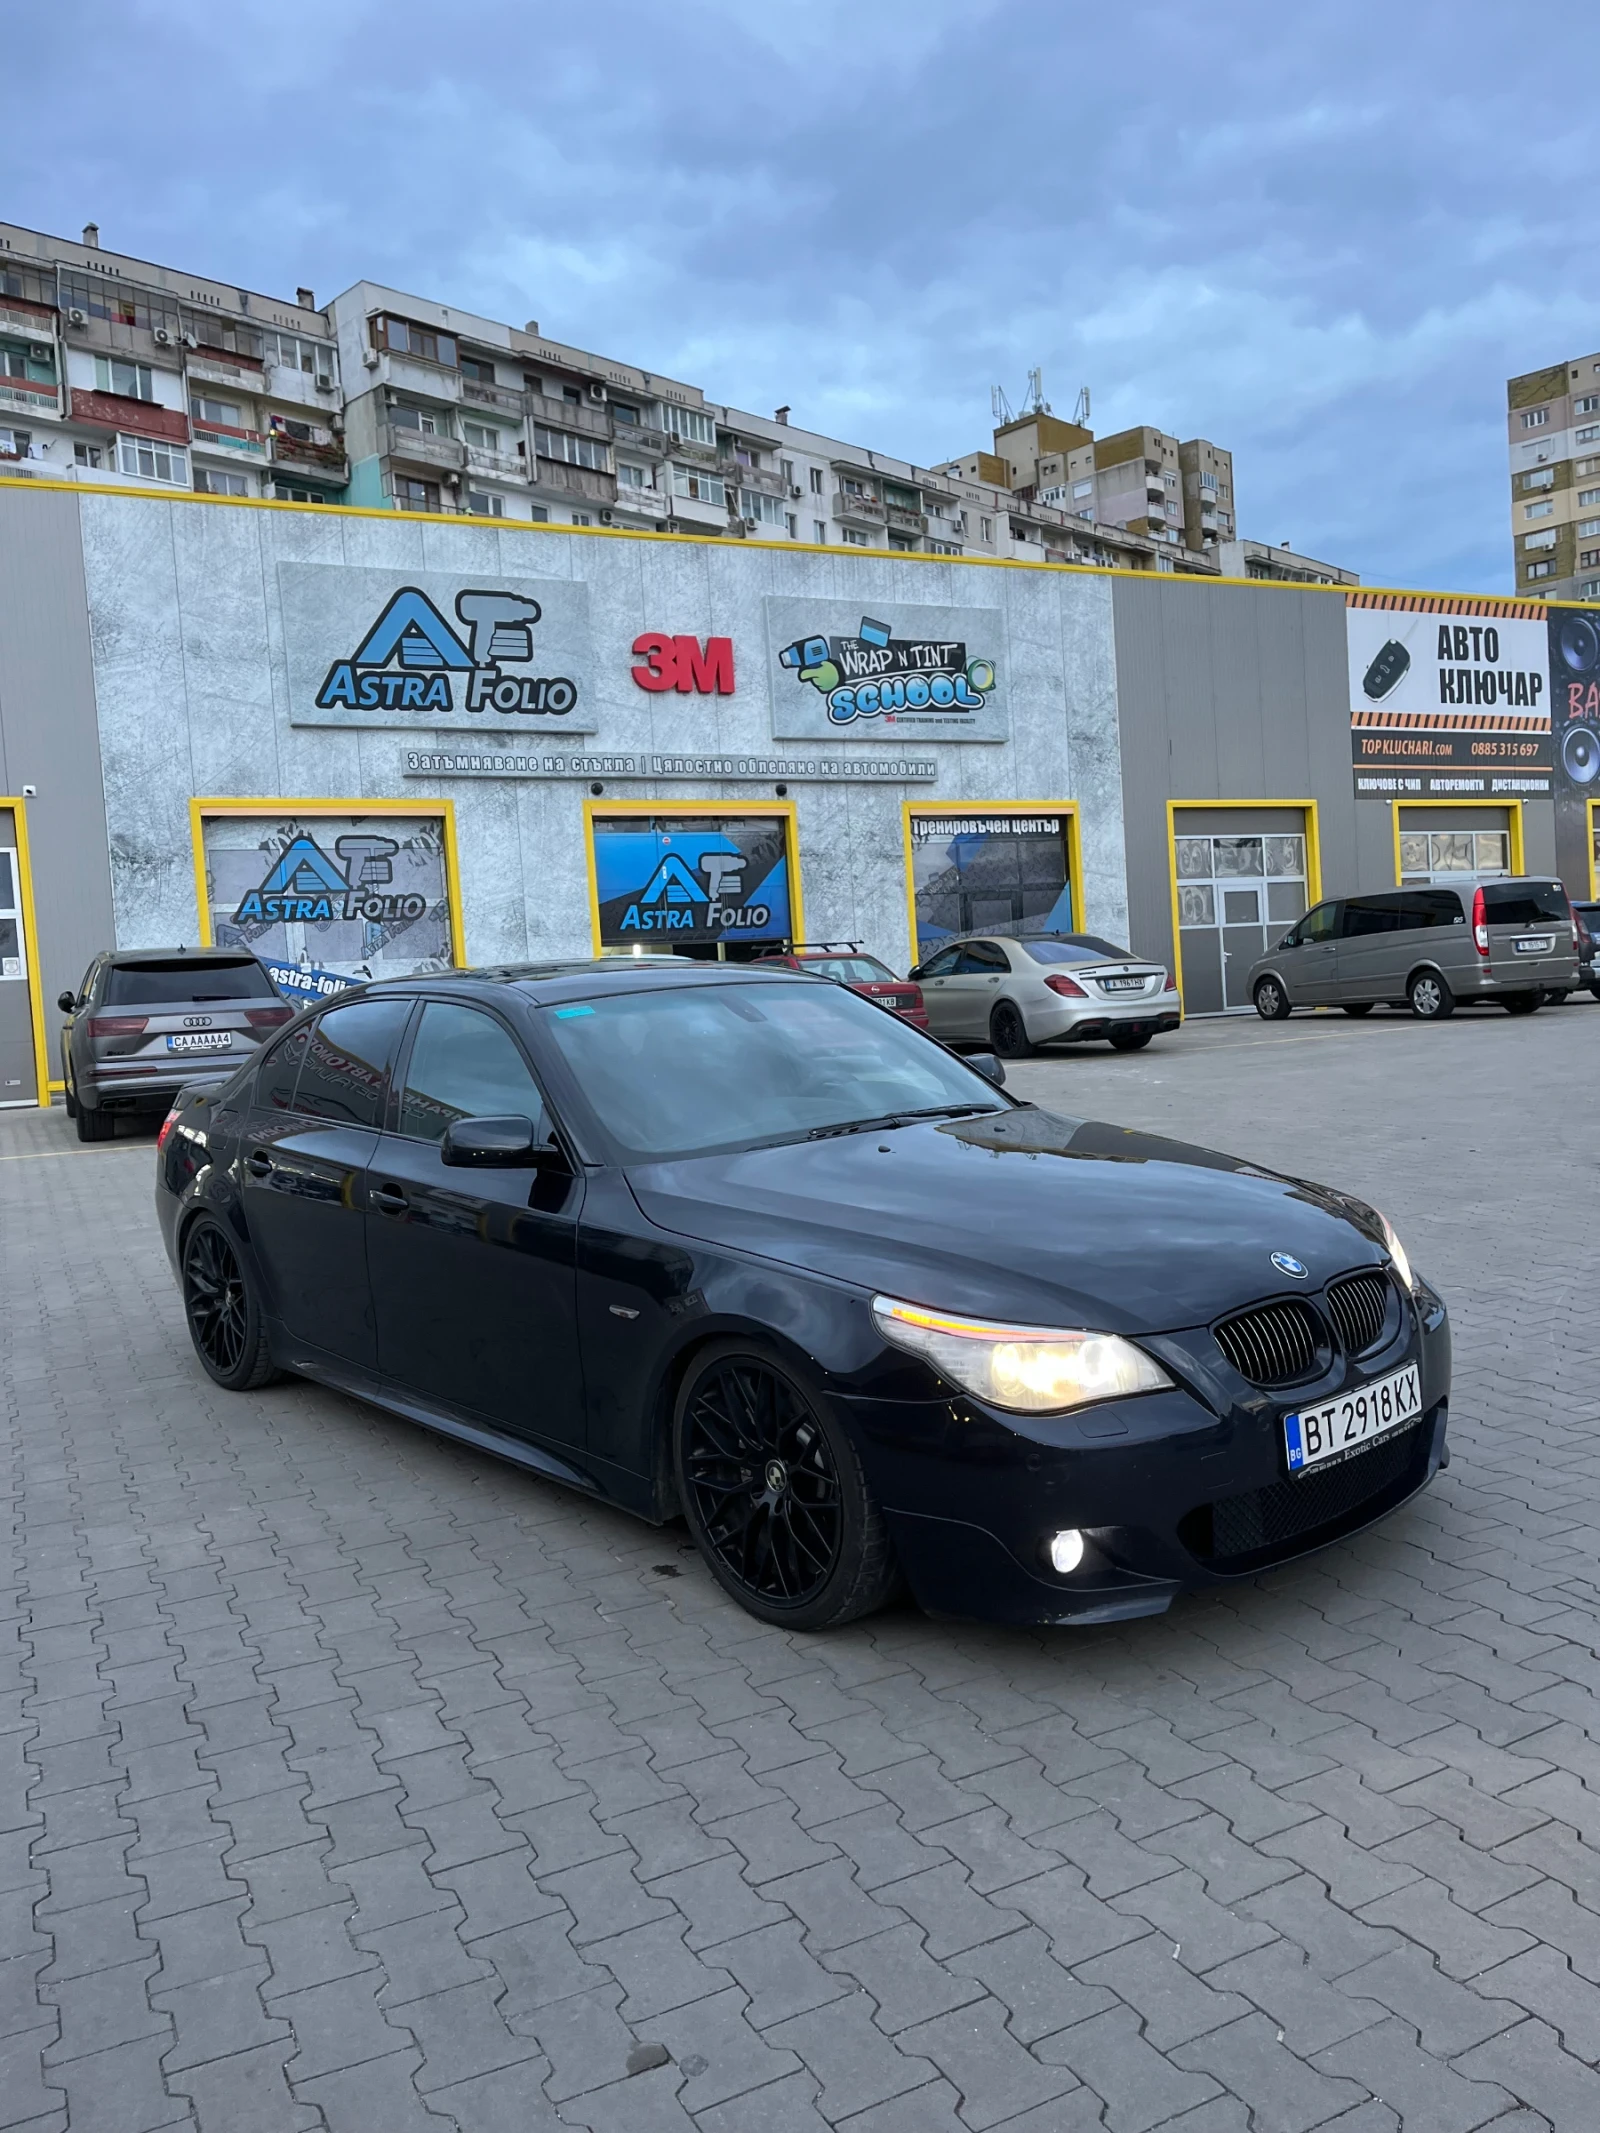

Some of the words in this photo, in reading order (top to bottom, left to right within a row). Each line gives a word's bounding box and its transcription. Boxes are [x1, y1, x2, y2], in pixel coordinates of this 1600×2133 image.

[841, 640, 859, 650] THE
[1437, 624, 1499, 663] АВТО
[631, 632, 736, 695] 3M
[839, 649, 893, 675] WRAP
[910, 644, 958, 667] TINT
[318, 662, 451, 709] ASTRA
[468, 669, 576, 712] FOLIO
[829, 673, 983, 723] SCHOOL
[1439, 668, 1543, 707] КЛЮЧАР
[1471, 742, 1497, 756] 0885
[1499, 743, 1518, 756] 315
[1520, 743, 1539, 757] 697
[408, 752, 538, 772] Затъмняване
[543, 755, 564, 771] на
[571, 755, 635, 773] стъкла
[652, 755, 732, 775] Цялостно
[738, 757, 815, 774] облепяне
[820, 759, 838, 775] на
[844, 760, 936, 777] автомобили
[1358, 778, 1397, 791] КЛЮЧОВЕ
[912, 818, 1010, 835] Тренировъчен
[1012, 818, 1060, 835] център
[236, 890, 331, 922] ASTRA
[344, 890, 424, 922] FOLIO
[620, 904, 694, 930] ASTRA
[706, 902, 769, 928] FOLIO
[1304, 1407, 1336, 1456] BT
[1341, 1385, 1392, 1441] 2918
[1290, 1447, 1302, 1462] BG
[1344, 1442, 1371, 1460] Exotic
[1372, 1433, 1390, 1447] Cars
